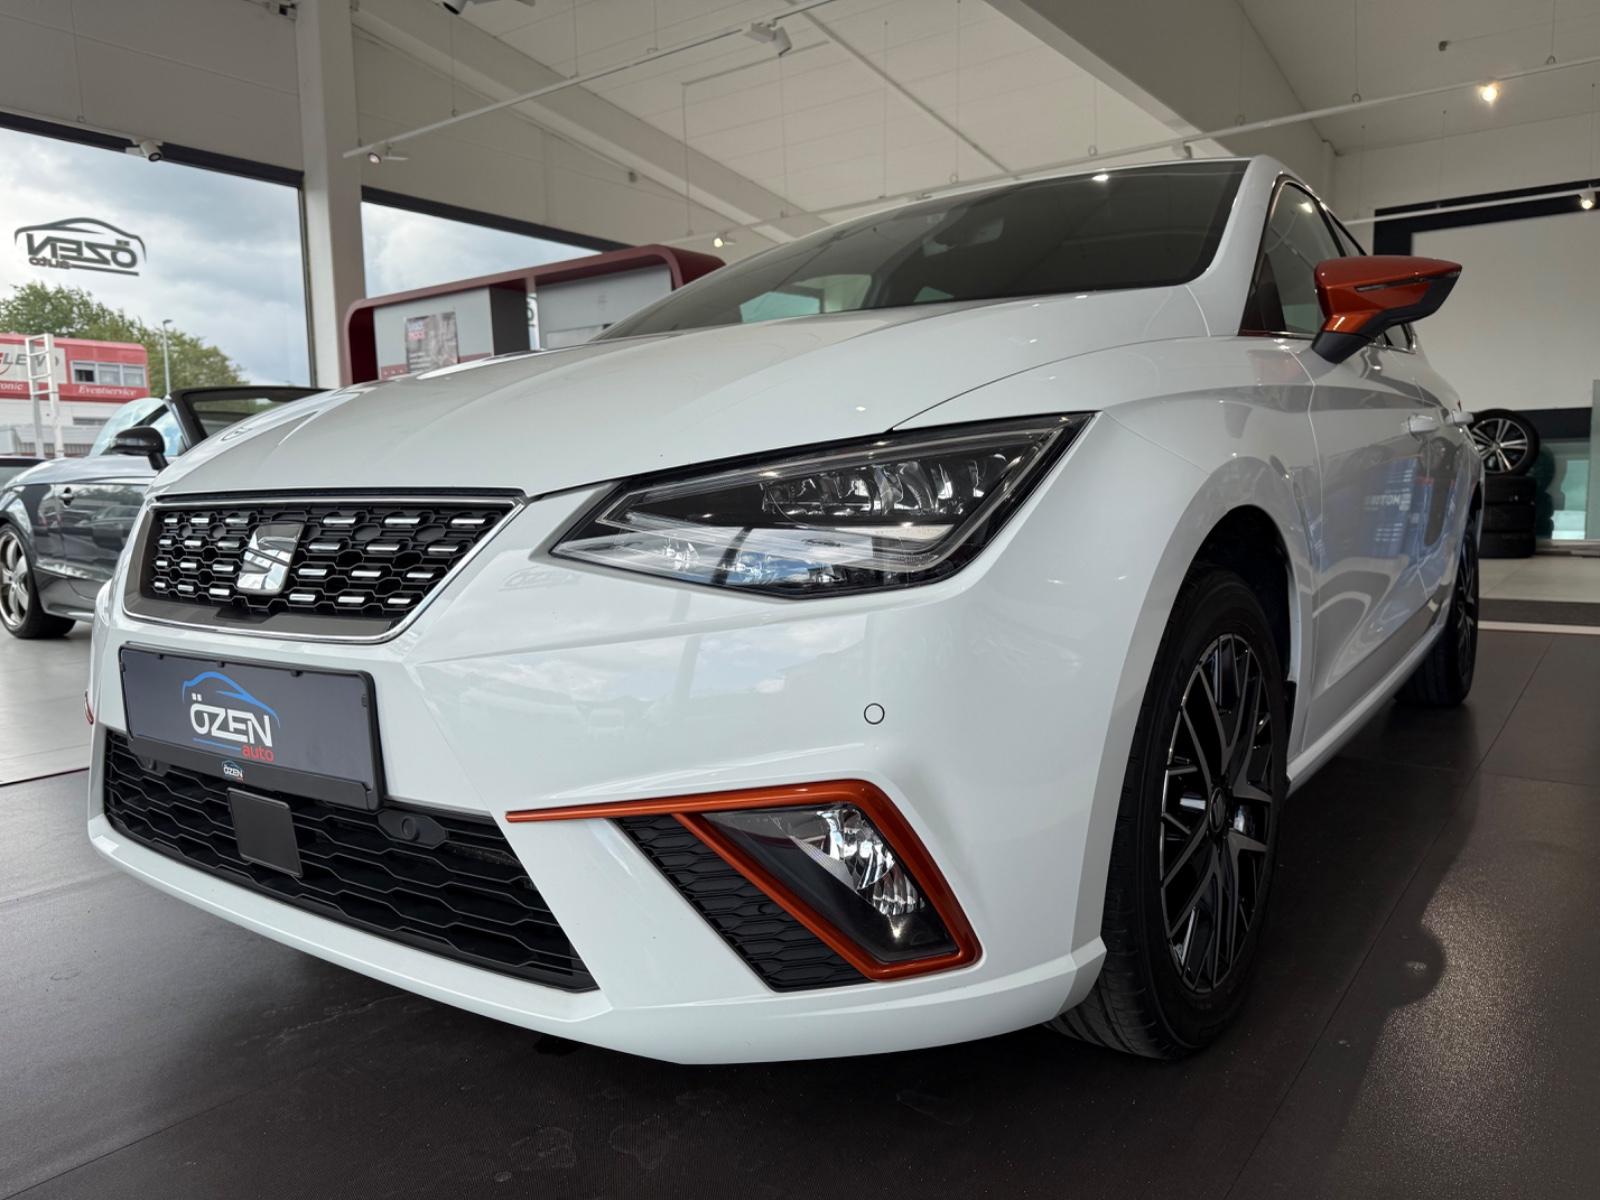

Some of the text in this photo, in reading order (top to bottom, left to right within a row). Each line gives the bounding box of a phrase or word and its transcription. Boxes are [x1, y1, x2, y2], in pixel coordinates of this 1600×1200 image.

[0, 382, 23, 391] onic
[190, 693, 273, 747] ÖZEN
[242, 745, 274, 761] auto
[223, 764, 243, 778] ÖZEN
